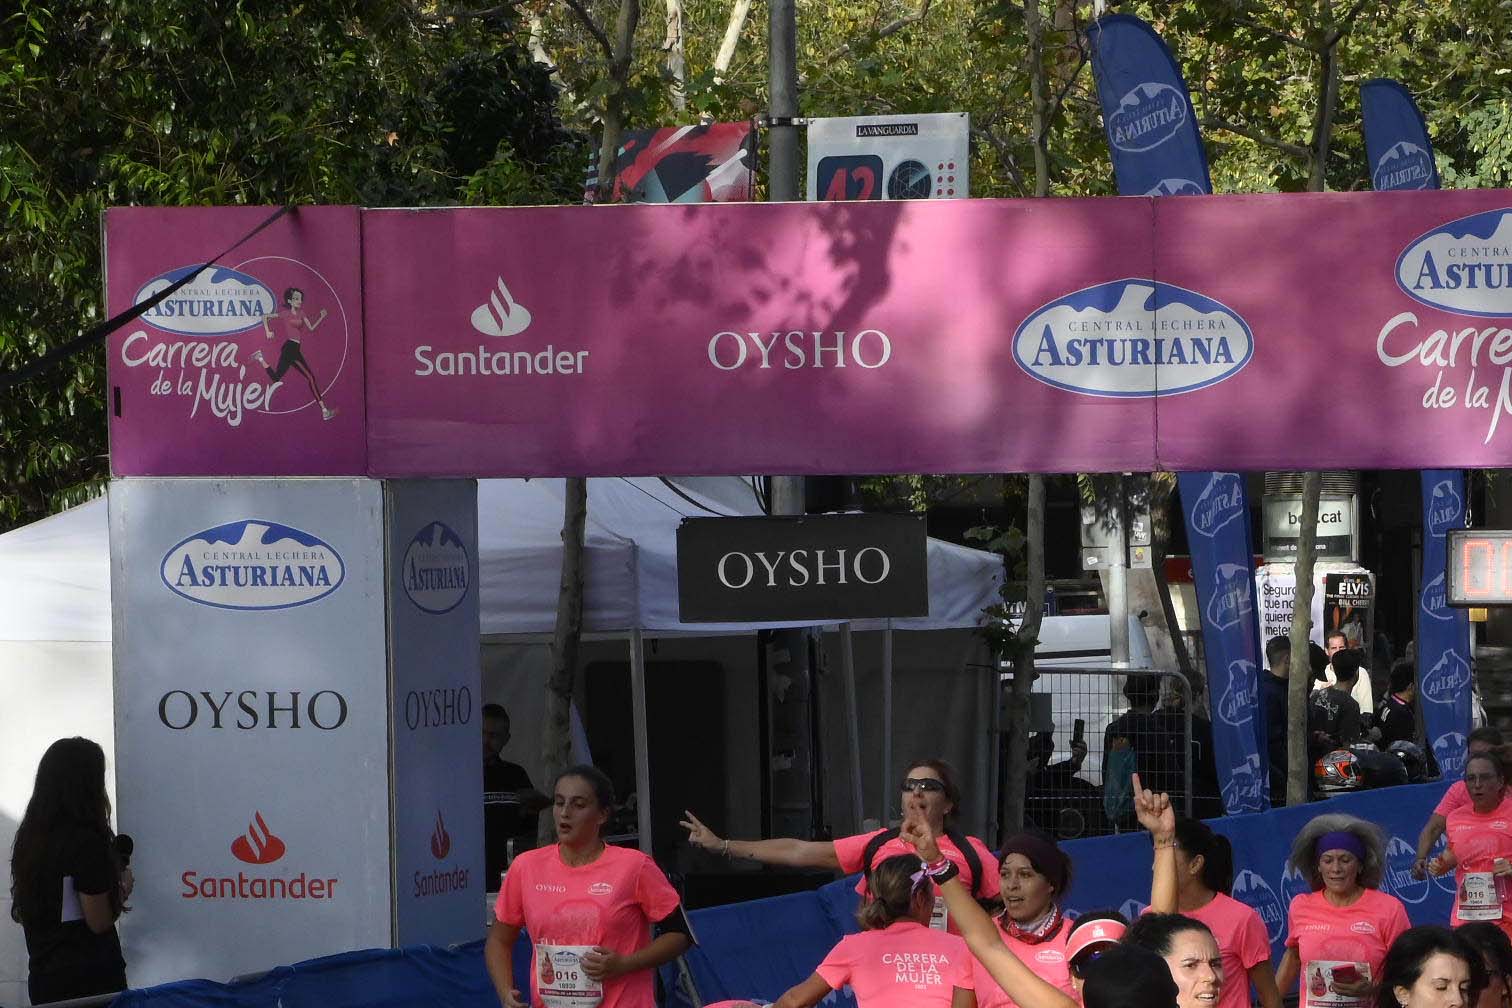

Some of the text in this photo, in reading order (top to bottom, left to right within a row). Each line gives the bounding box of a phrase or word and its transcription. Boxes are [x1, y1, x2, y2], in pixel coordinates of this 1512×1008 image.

[868, 125, 918, 136] VANGUARDIA
[1448, 245, 1510, 258] CENTRAL
[1068, 318, 1226, 333] CENTRAL LECHERA
[121, 331, 238, 369] Carrera
[414, 345, 588, 376] Santander
[708, 329, 892, 370] OYSHO
[1031, 324, 1234, 367] ASTURIANA
[151, 365, 283, 427] de la Mujer
[1422, 371, 1457, 409] de
[1464, 371, 1490, 409] la
[203, 550, 325, 560] CENTRAL LECHERA
[717, 547, 891, 589] OYSHO
[175, 554, 332, 587] ASTURIANA
[408, 557, 466, 591] ASTURIANA
[1338, 582, 1369, 594] ELVIS
[1264, 600, 1280, 610] que
[158, 690, 348, 730] OYSHO
[406, 686, 472, 731] OYSHO
[182, 871, 338, 900] Santander
[414, 868, 470, 898] Santander
[882, 953, 949, 965] CARRERA
[897, 962, 938, 974] DE LA
[555, 971, 578, 981] 016
[895, 973, 943, 985] MUJER
